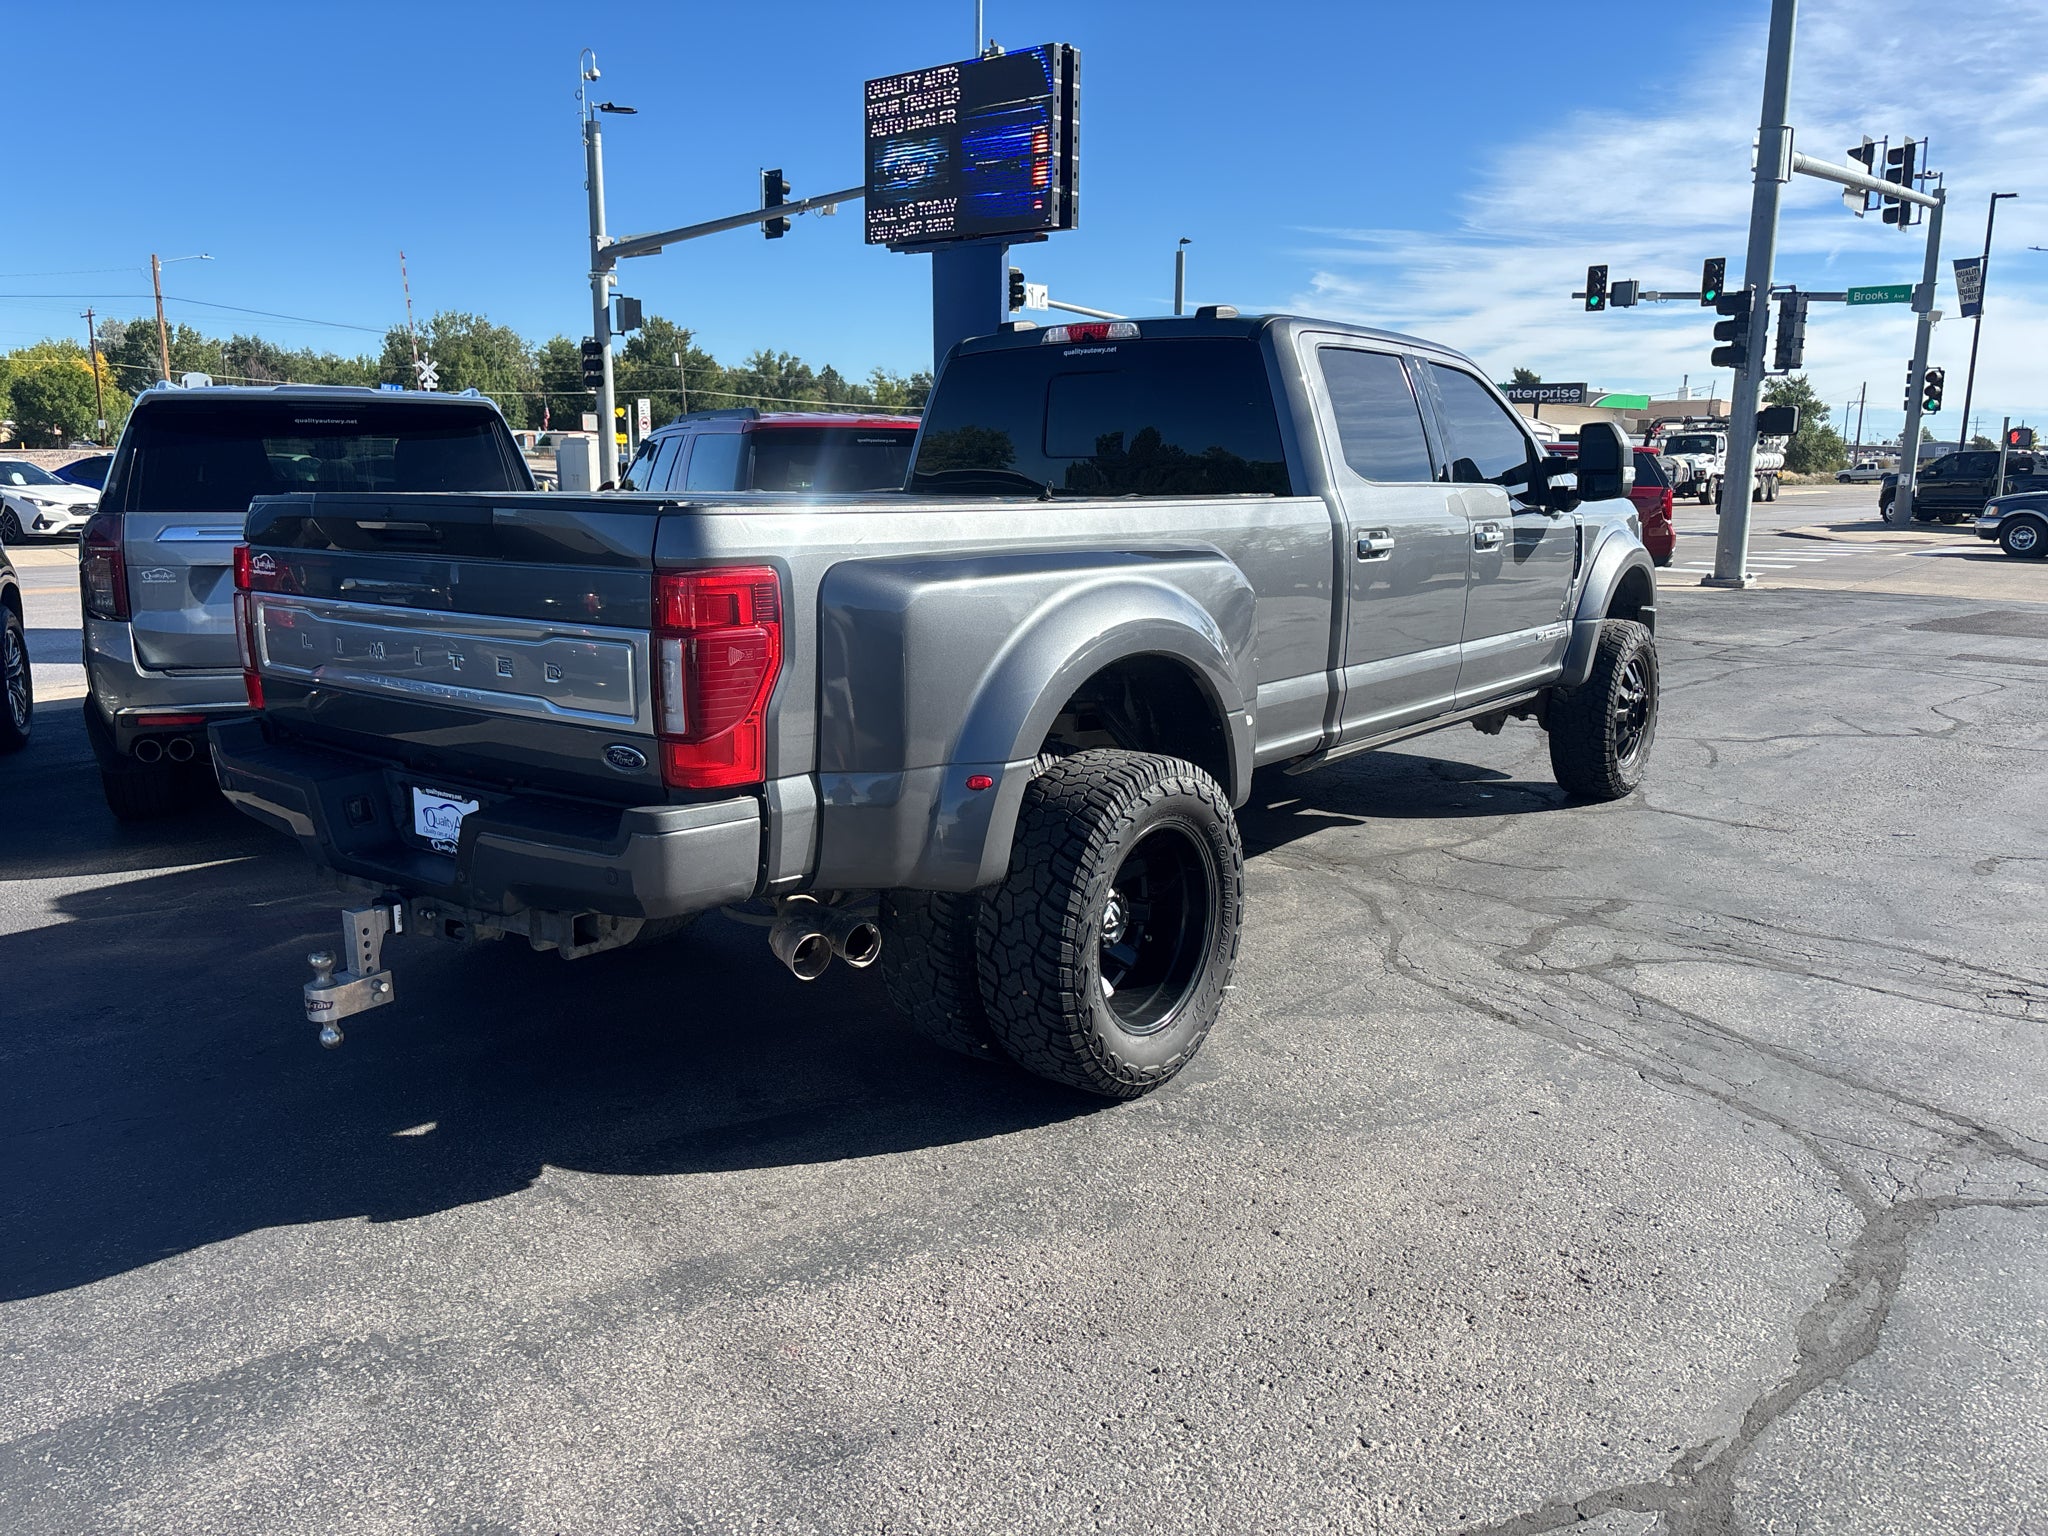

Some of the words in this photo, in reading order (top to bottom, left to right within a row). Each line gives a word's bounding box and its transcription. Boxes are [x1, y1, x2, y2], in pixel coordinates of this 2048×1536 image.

[868, 74, 921, 99] QUALITY
[922, 66, 959, 90] AUTO
[867, 99, 900, 119] YOUR
[902, 87, 960, 113] TRUSTED
[870, 118, 904, 138] AUTO
[906, 108, 957, 131] DEALER
[868, 207, 898, 223] CALL
[899, 203, 915, 219] US
[917, 197, 958, 216] TODAY
[1853, 290, 1889, 301] Brooks
[1063, 346, 1117, 357] qualityautowy.net
[1506, 386, 1580, 401] nterprise
[301, 632, 563, 683] LIMITED
[612, 750, 635, 767] Ford
[425, 809, 454, 831] Quality
